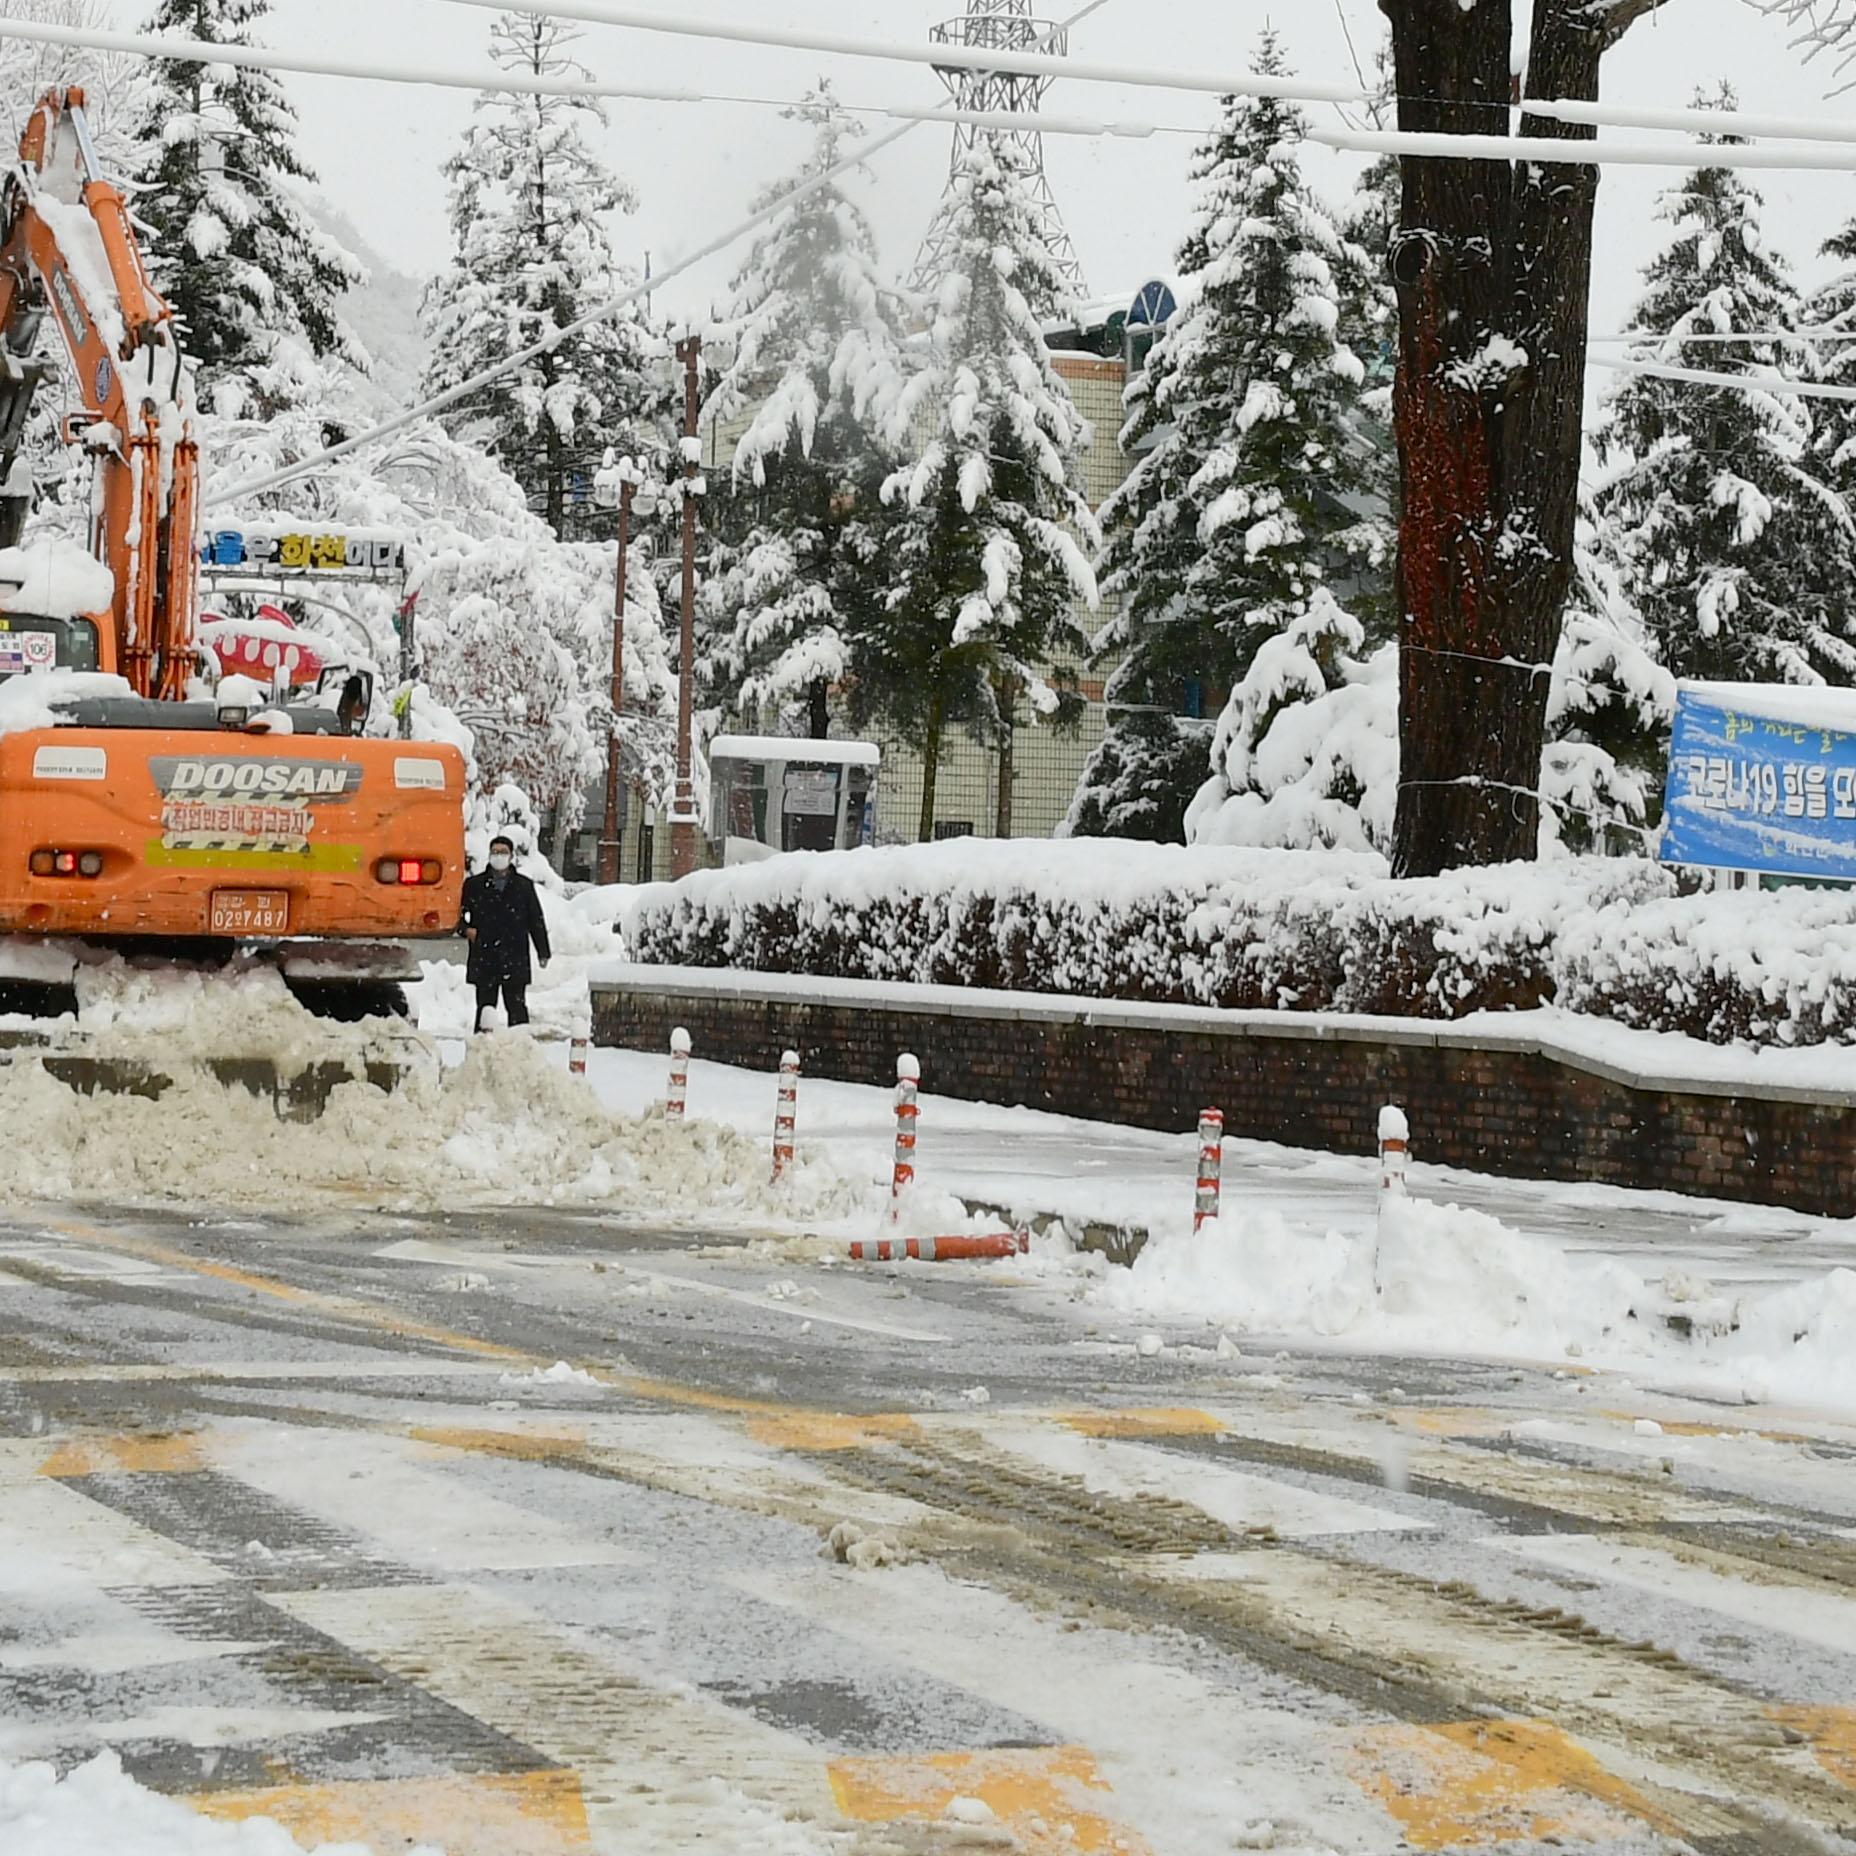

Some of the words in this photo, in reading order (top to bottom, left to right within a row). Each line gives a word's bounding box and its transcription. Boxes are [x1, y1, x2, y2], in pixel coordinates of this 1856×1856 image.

[53, 270, 86, 343] DOOSAN
[170, 763, 347, 794] DOOSAN
[1781, 761, 1828, 819] 힘을
